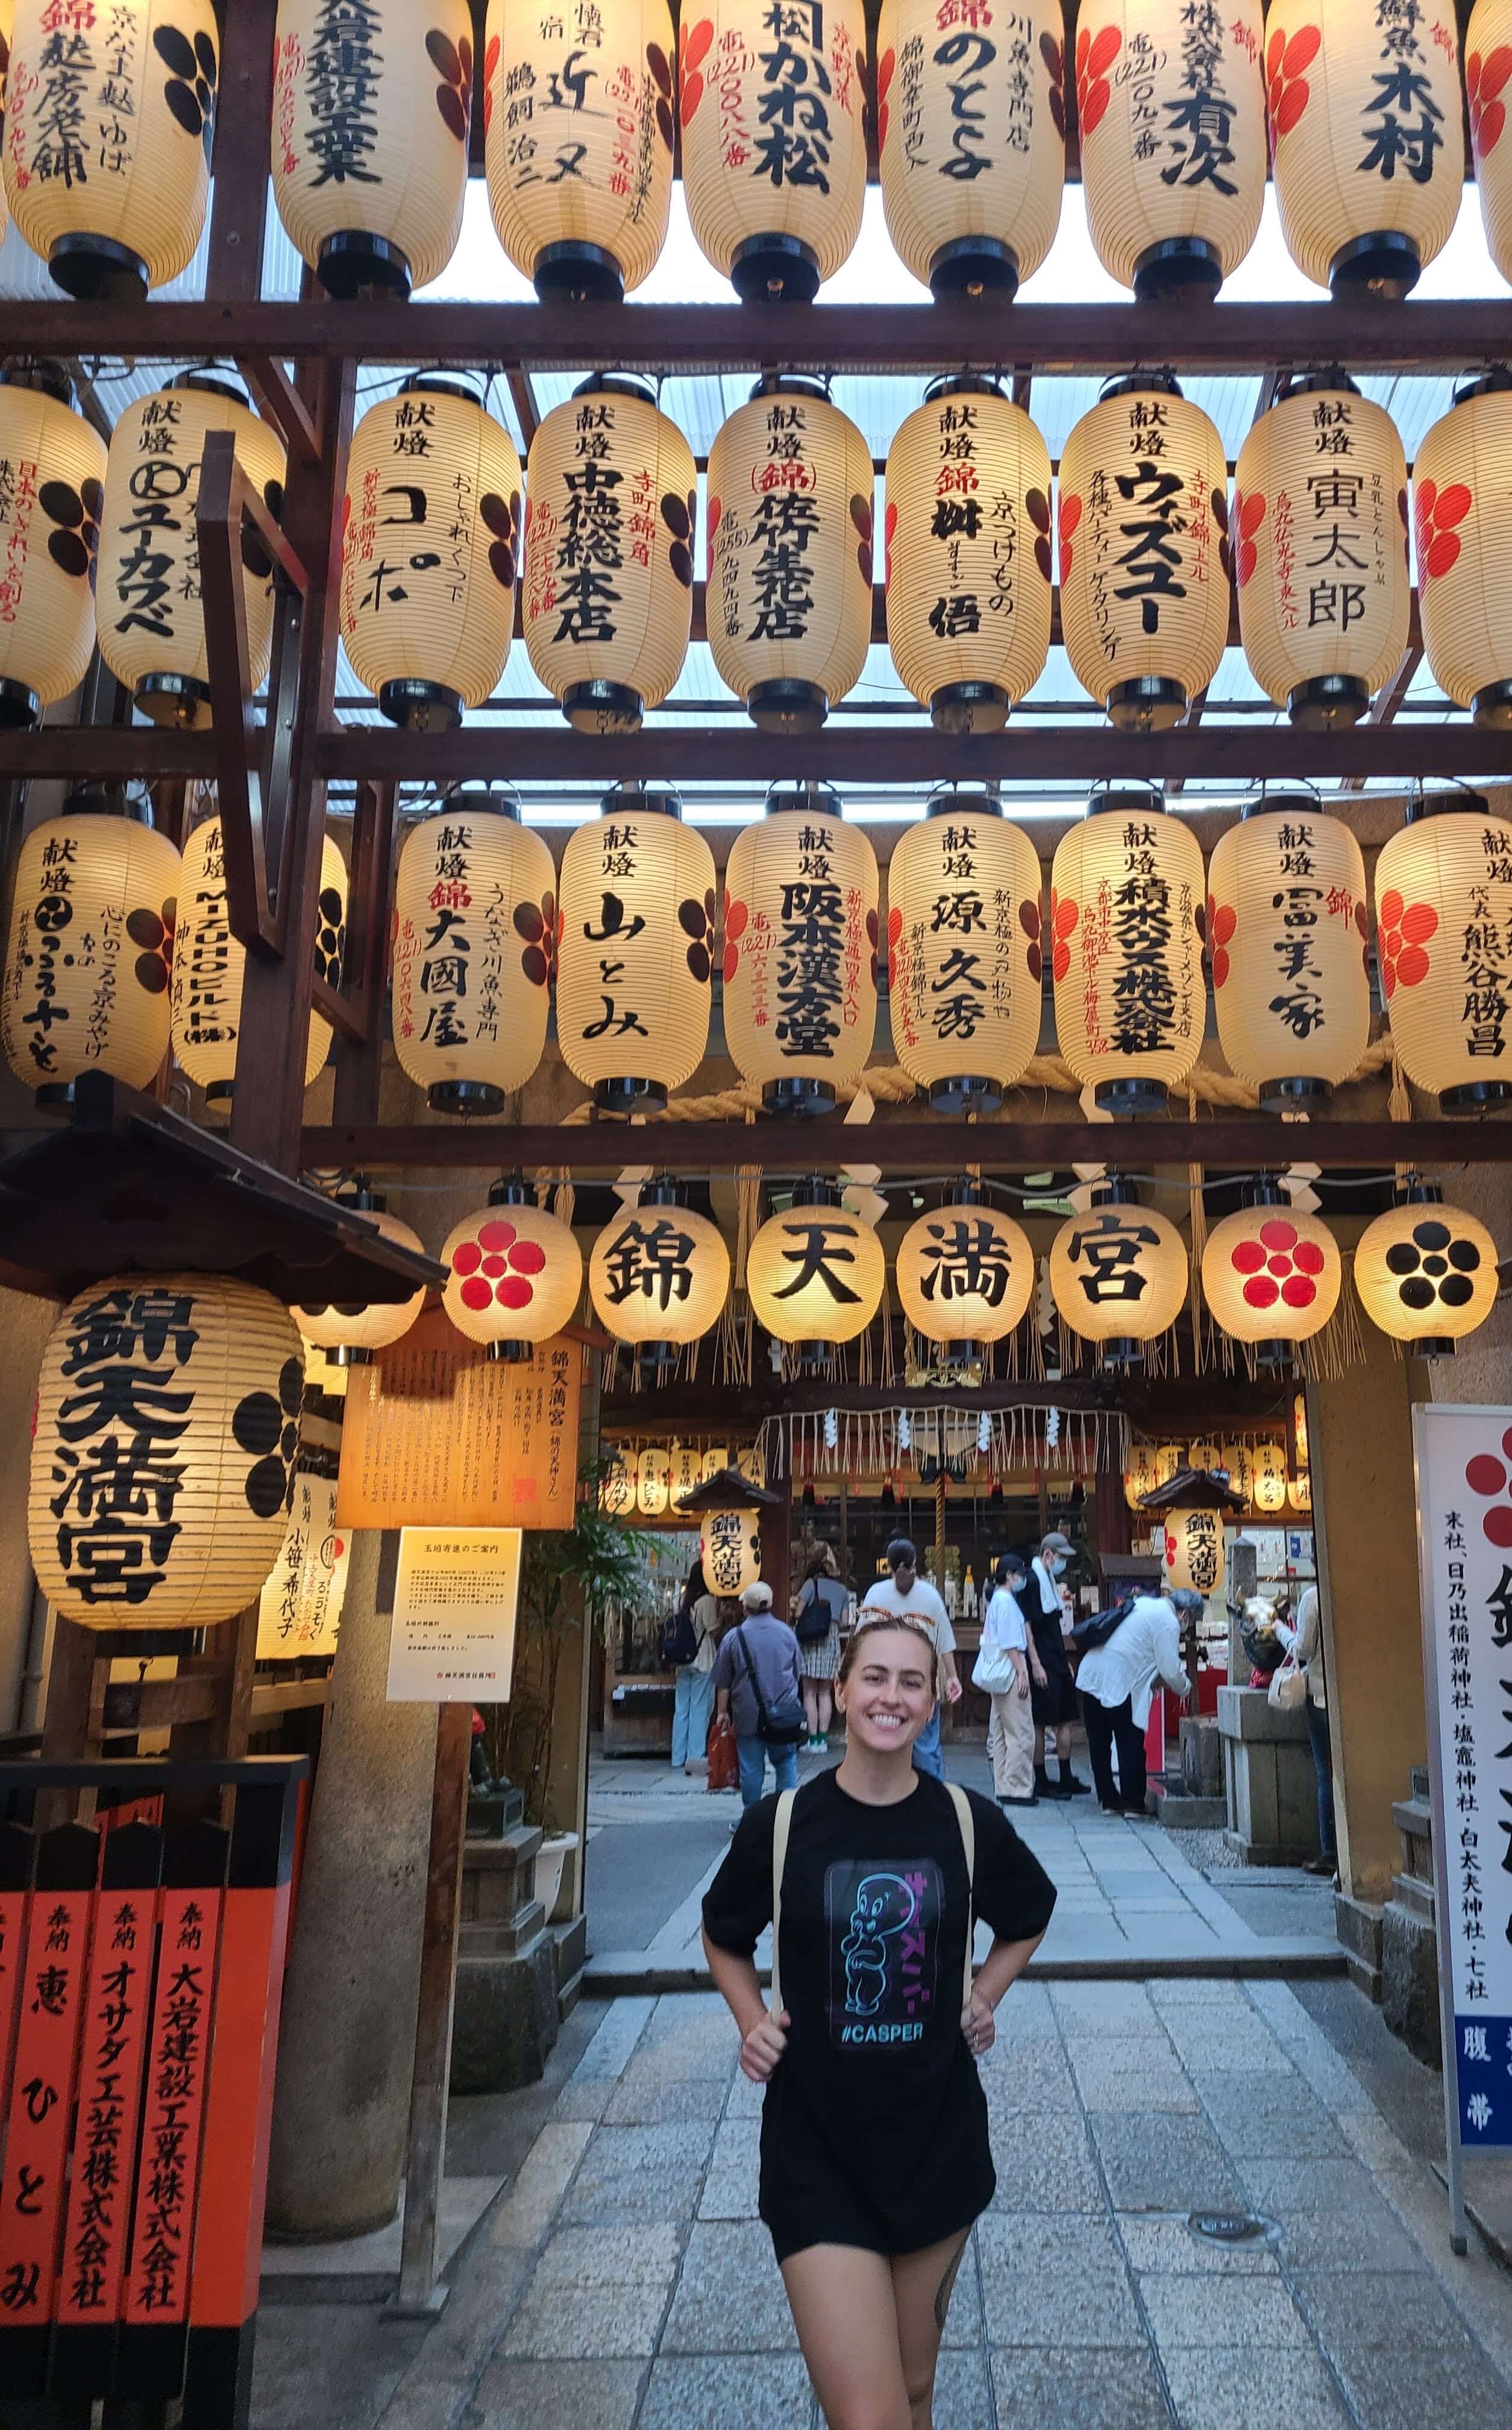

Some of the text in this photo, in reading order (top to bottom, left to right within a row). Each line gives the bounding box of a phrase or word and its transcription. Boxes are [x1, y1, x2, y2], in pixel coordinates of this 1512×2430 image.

[1179, 0, 1226, 95] 株式会社
[752, 42, 832, 194] かね松
[933, 31, 997, 179] のとよ
[1161, 87, 1239, 196] 有次
[1356, 63, 1446, 184] 木村
[137, 398, 182, 455] 献燈
[392, 401, 436, 459] 献燈
[574, 405, 616, 460] 献燈
[766, 405, 807, 460] 献燈
[940, 405, 979, 460] 献燈
[1129, 401, 1169, 457] 献燈
[1313, 400, 1354, 456] 献燈
[751, 458, 817, 493] (錦)
[934, 462, 980, 497] 錦
[551, 462, 624, 644] 中徳総本店
[627, 468, 656, 567] 寺町錦角
[988, 491, 1017, 617] 京つけもの
[1112, 461, 1188, 635] ウィズユー
[1306, 468, 1369, 632] 寅太郎
[746, 492, 820, 642] 佐竹生花店
[40, 838, 78, 893] 献燈
[435, 826, 472, 879] 献燈
[602, 825, 638, 877] 献燈
[798, 826, 835, 881] 献燈
[941, 826, 977, 879] 献燈
[1123, 823, 1158, 875] 献燈
[1278, 824, 1316, 878] 献燈
[427, 880, 472, 909] 錦
[1325, 886, 1352, 930] 錦
[420, 910, 471, 1046] 大國屋
[582, 892, 648, 1038] 山とみ
[774, 884, 845, 1056] 阪本漢方堂
[1110, 877, 1175, 1055] 積水ハウス株式会社
[1461, 923, 1511, 1057] 熊谷勝昌
[603, 1215, 1161, 1311] 錦 天 満 宮
[549, 1350, 569, 1427] 錦天満宮
[49, 1289, 200, 1604] 錦天満宮
[711, 1514, 741, 1590] 錦天満宮
[1185, 1512, 1217, 1587] 錦天満宮
[841, 2022, 923, 2044] #CASPER
[69, 1962, 137, 2310] オサダ工芸株式会社
[136, 1963, 205, 2312] 大岩建設工業株式会社
